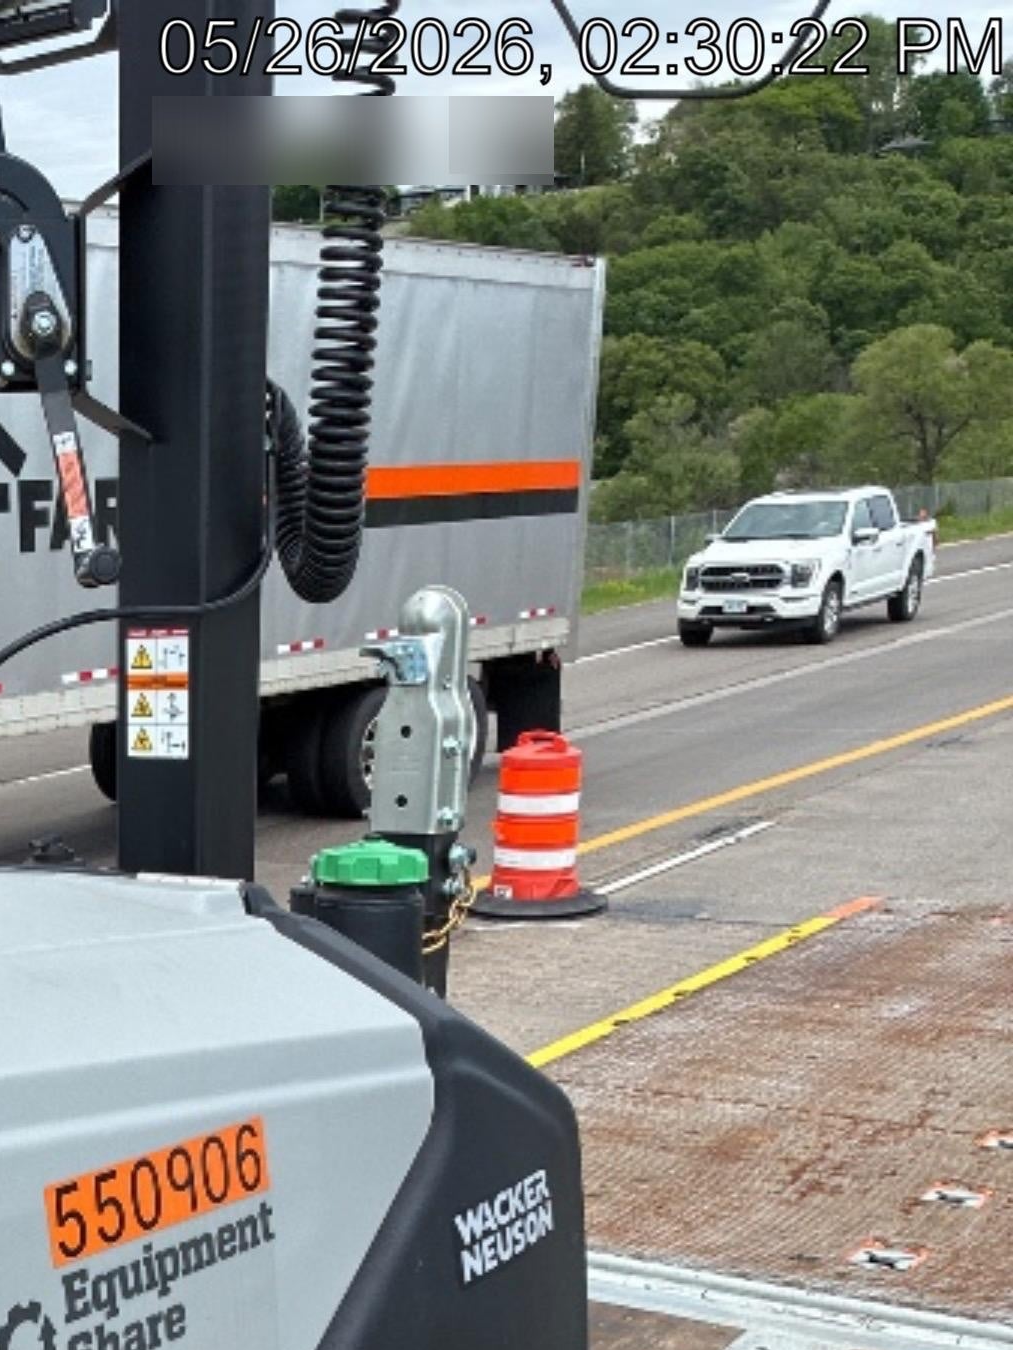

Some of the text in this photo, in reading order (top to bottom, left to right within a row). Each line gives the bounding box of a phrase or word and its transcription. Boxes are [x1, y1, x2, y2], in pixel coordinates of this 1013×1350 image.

[17, 478, 119, 553] FAR
[54, 1124, 262, 1258] 550906
[454, 1169, 550, 1246] WACKER
[61, 1200, 276, 1323] Equipment
[460, 1199, 554, 1284] NEUSON
